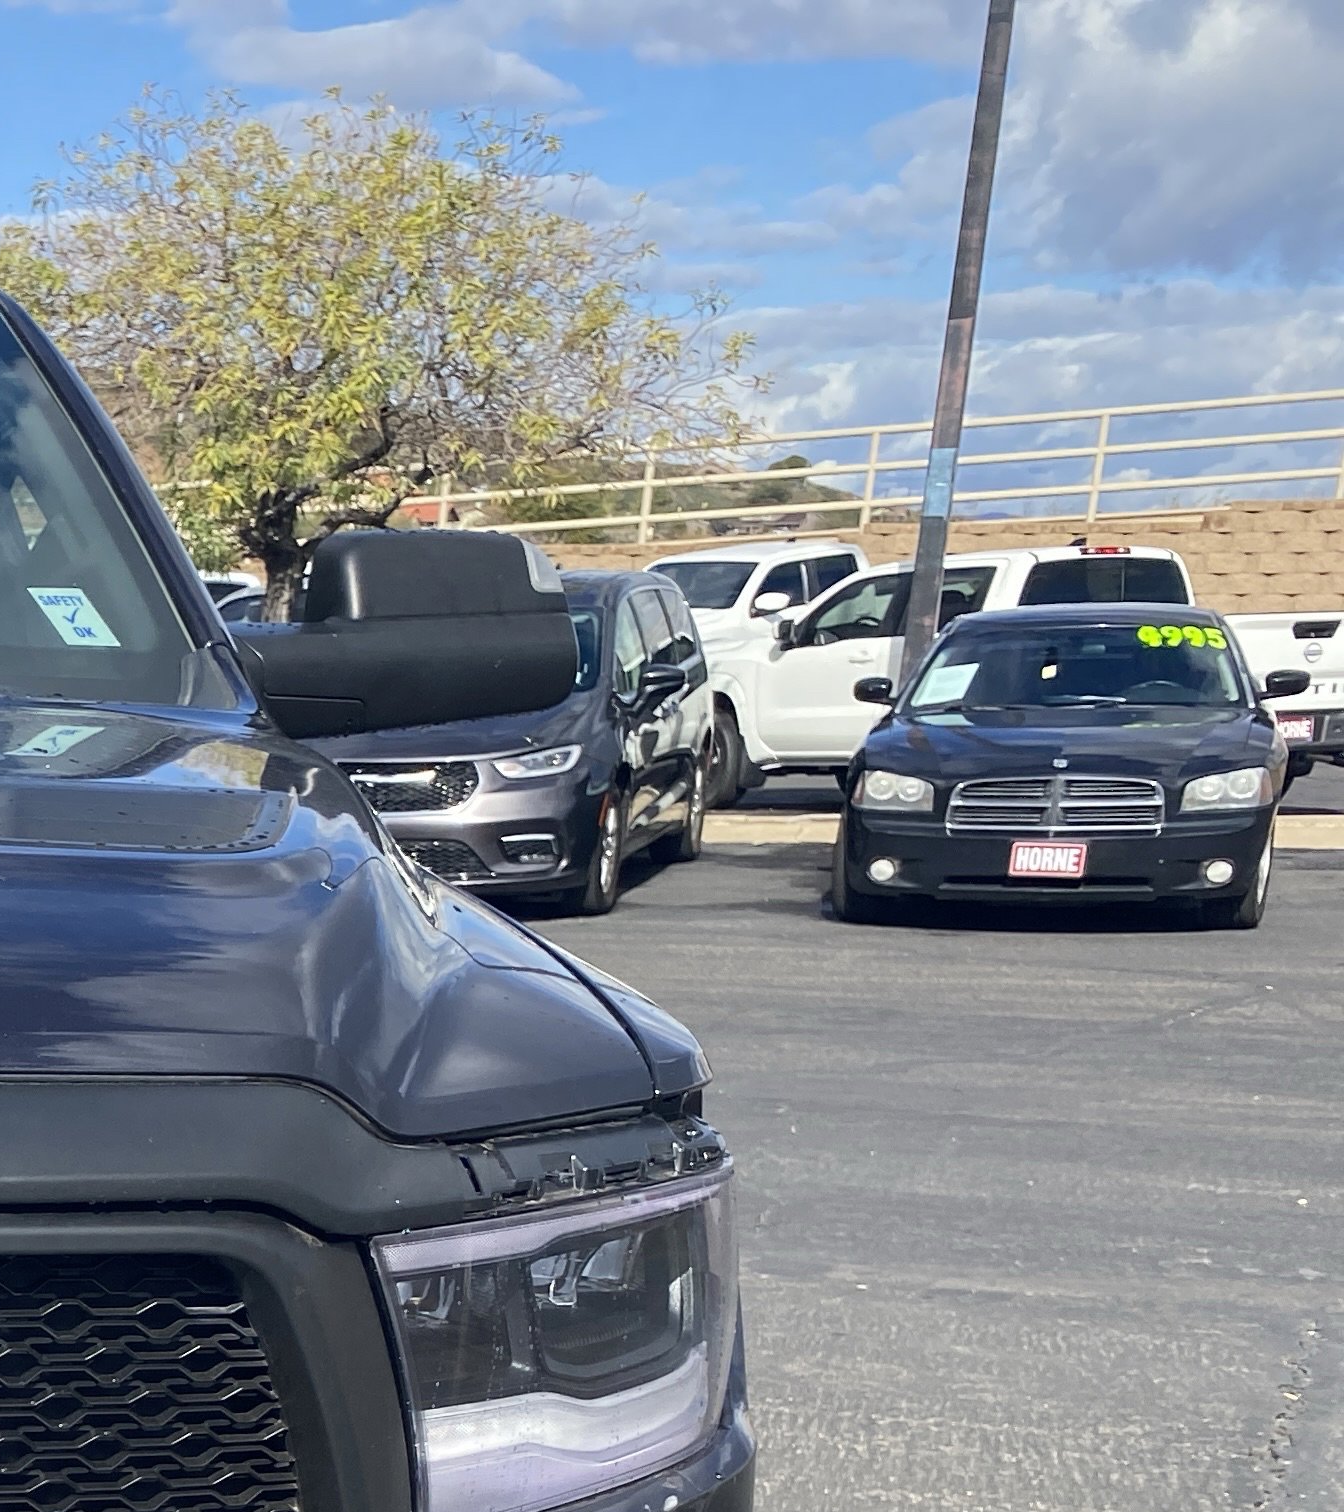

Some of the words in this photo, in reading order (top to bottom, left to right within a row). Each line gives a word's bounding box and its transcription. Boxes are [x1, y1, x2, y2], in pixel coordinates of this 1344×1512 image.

[38, 595, 84, 606] SAFETY
[73, 626, 98, 638] OK
[1015, 846, 1081, 872] HORNE
